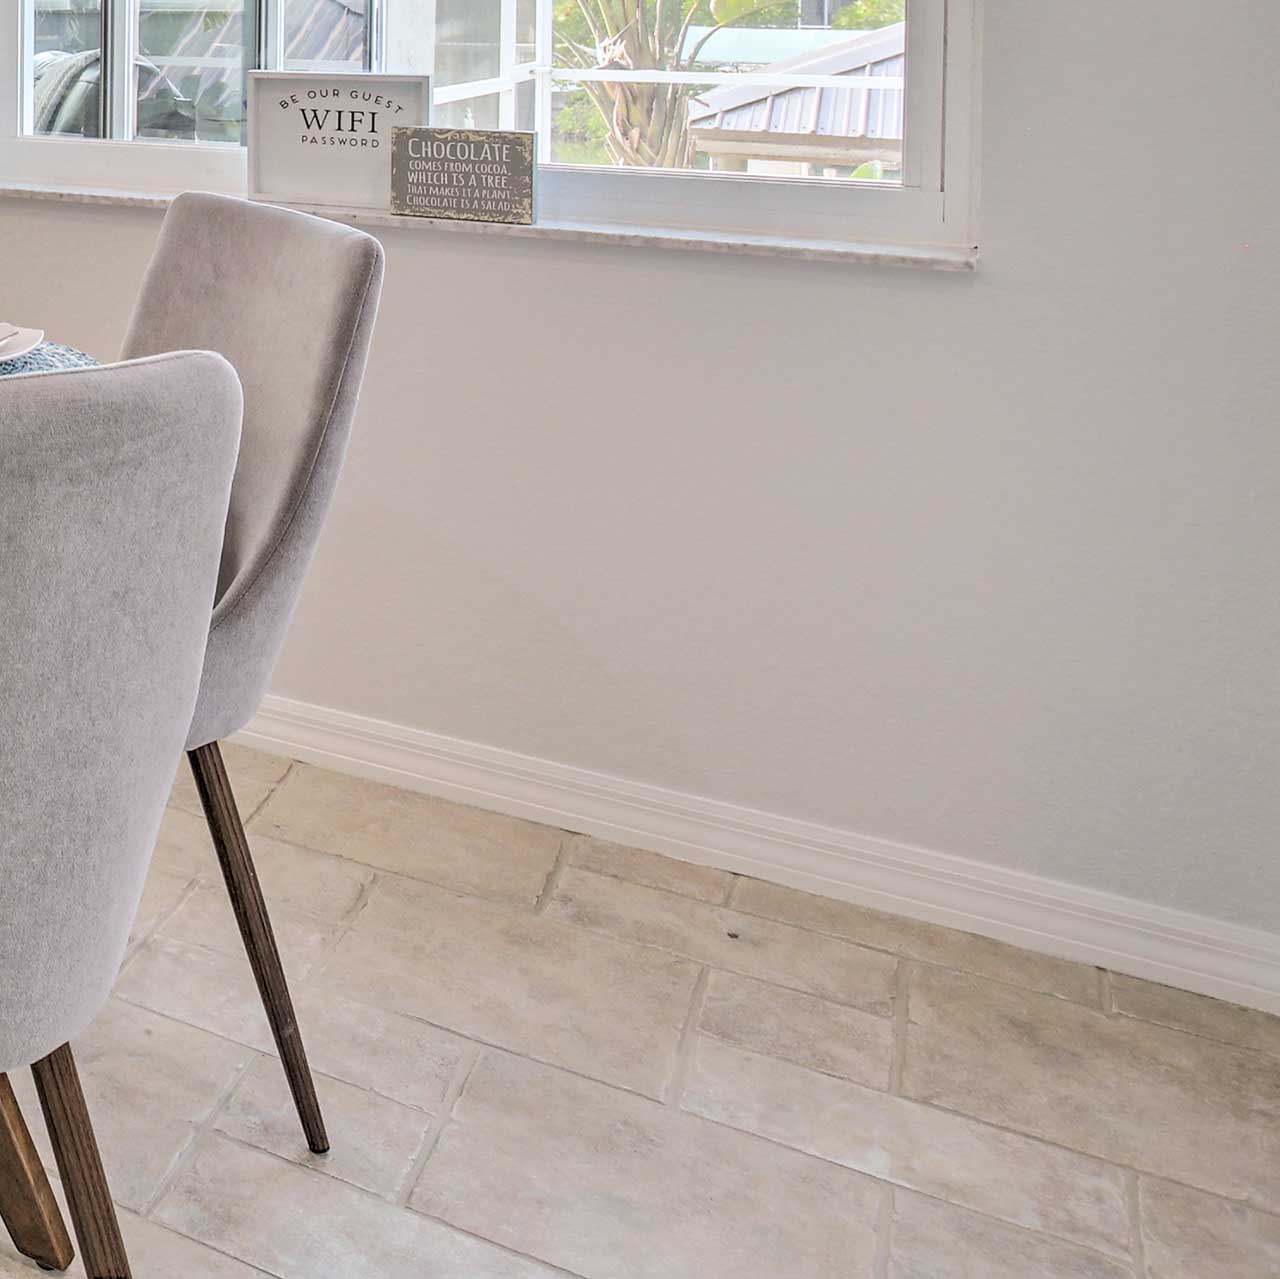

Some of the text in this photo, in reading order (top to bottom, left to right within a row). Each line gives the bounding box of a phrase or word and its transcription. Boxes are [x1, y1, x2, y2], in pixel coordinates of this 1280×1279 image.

[279, 89, 404, 114] BE OUR GUEST
[299, 108, 379, 134] WIFI
[301, 135, 380, 149] PASSWORD
[408, 138, 511, 162] CHOCOLATE
[408, 160, 443, 172] COMES
[444, 161, 473, 174] FROM
[407, 171, 448, 185] WHICH
[452, 173, 465, 187] IS
[468, 174, 477, 187] A
[407, 184, 427, 195] THAT
[429, 186, 460, 197] MAKES
[462, 188, 472, 198] IT
[473, 189, 480, 199] A
[406, 194, 458, 209] CHOCOLATE
[461, 198, 471, 209] IS
[472, 199, 479, 209] A
